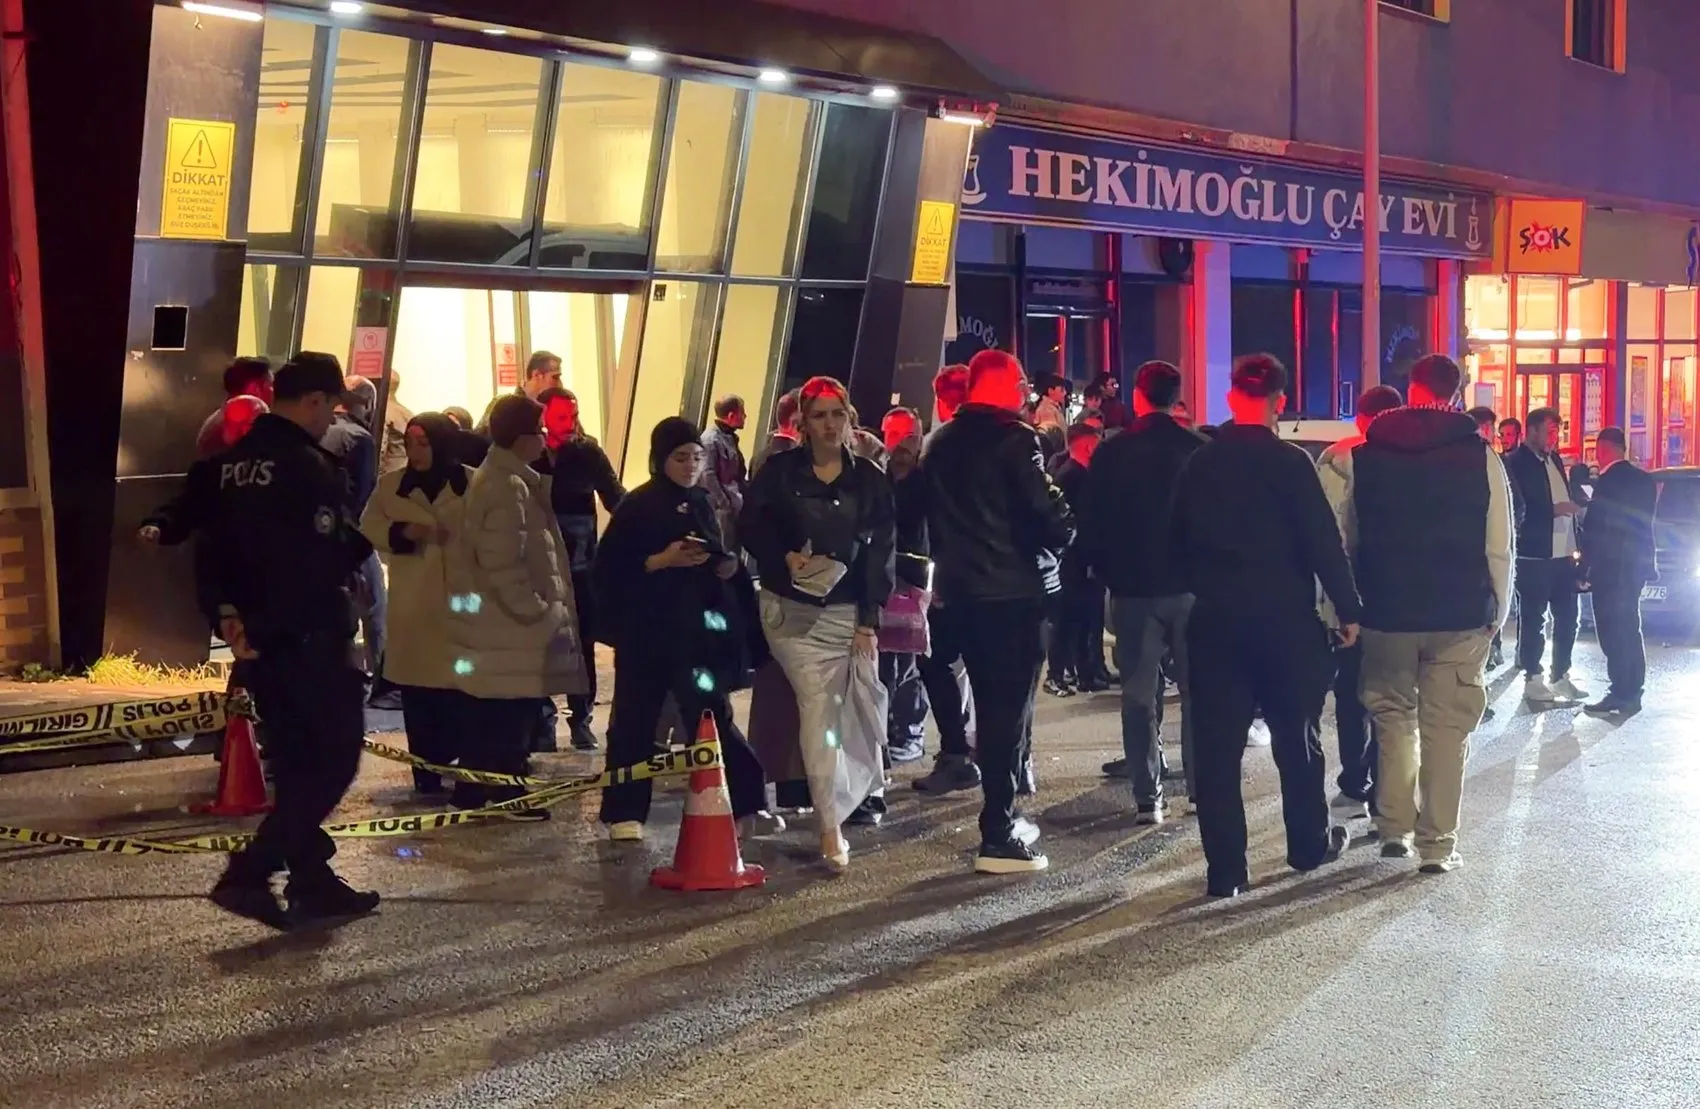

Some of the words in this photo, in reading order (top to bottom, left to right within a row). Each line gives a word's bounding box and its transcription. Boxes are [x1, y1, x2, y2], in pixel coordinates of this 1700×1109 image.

[171, 168, 226, 187] DİKKAT
[1008, 145, 1315, 226] HEKİMOĞLU
[1323, 188, 1395, 240] ÇAY
[1401, 192, 1457, 238] EVİ
[920, 236, 948, 247] DİKKAT
[1519, 226, 1571, 254] ŞOK
[220, 459, 276, 489] POİS
[646, 746, 720, 773] OLİS
